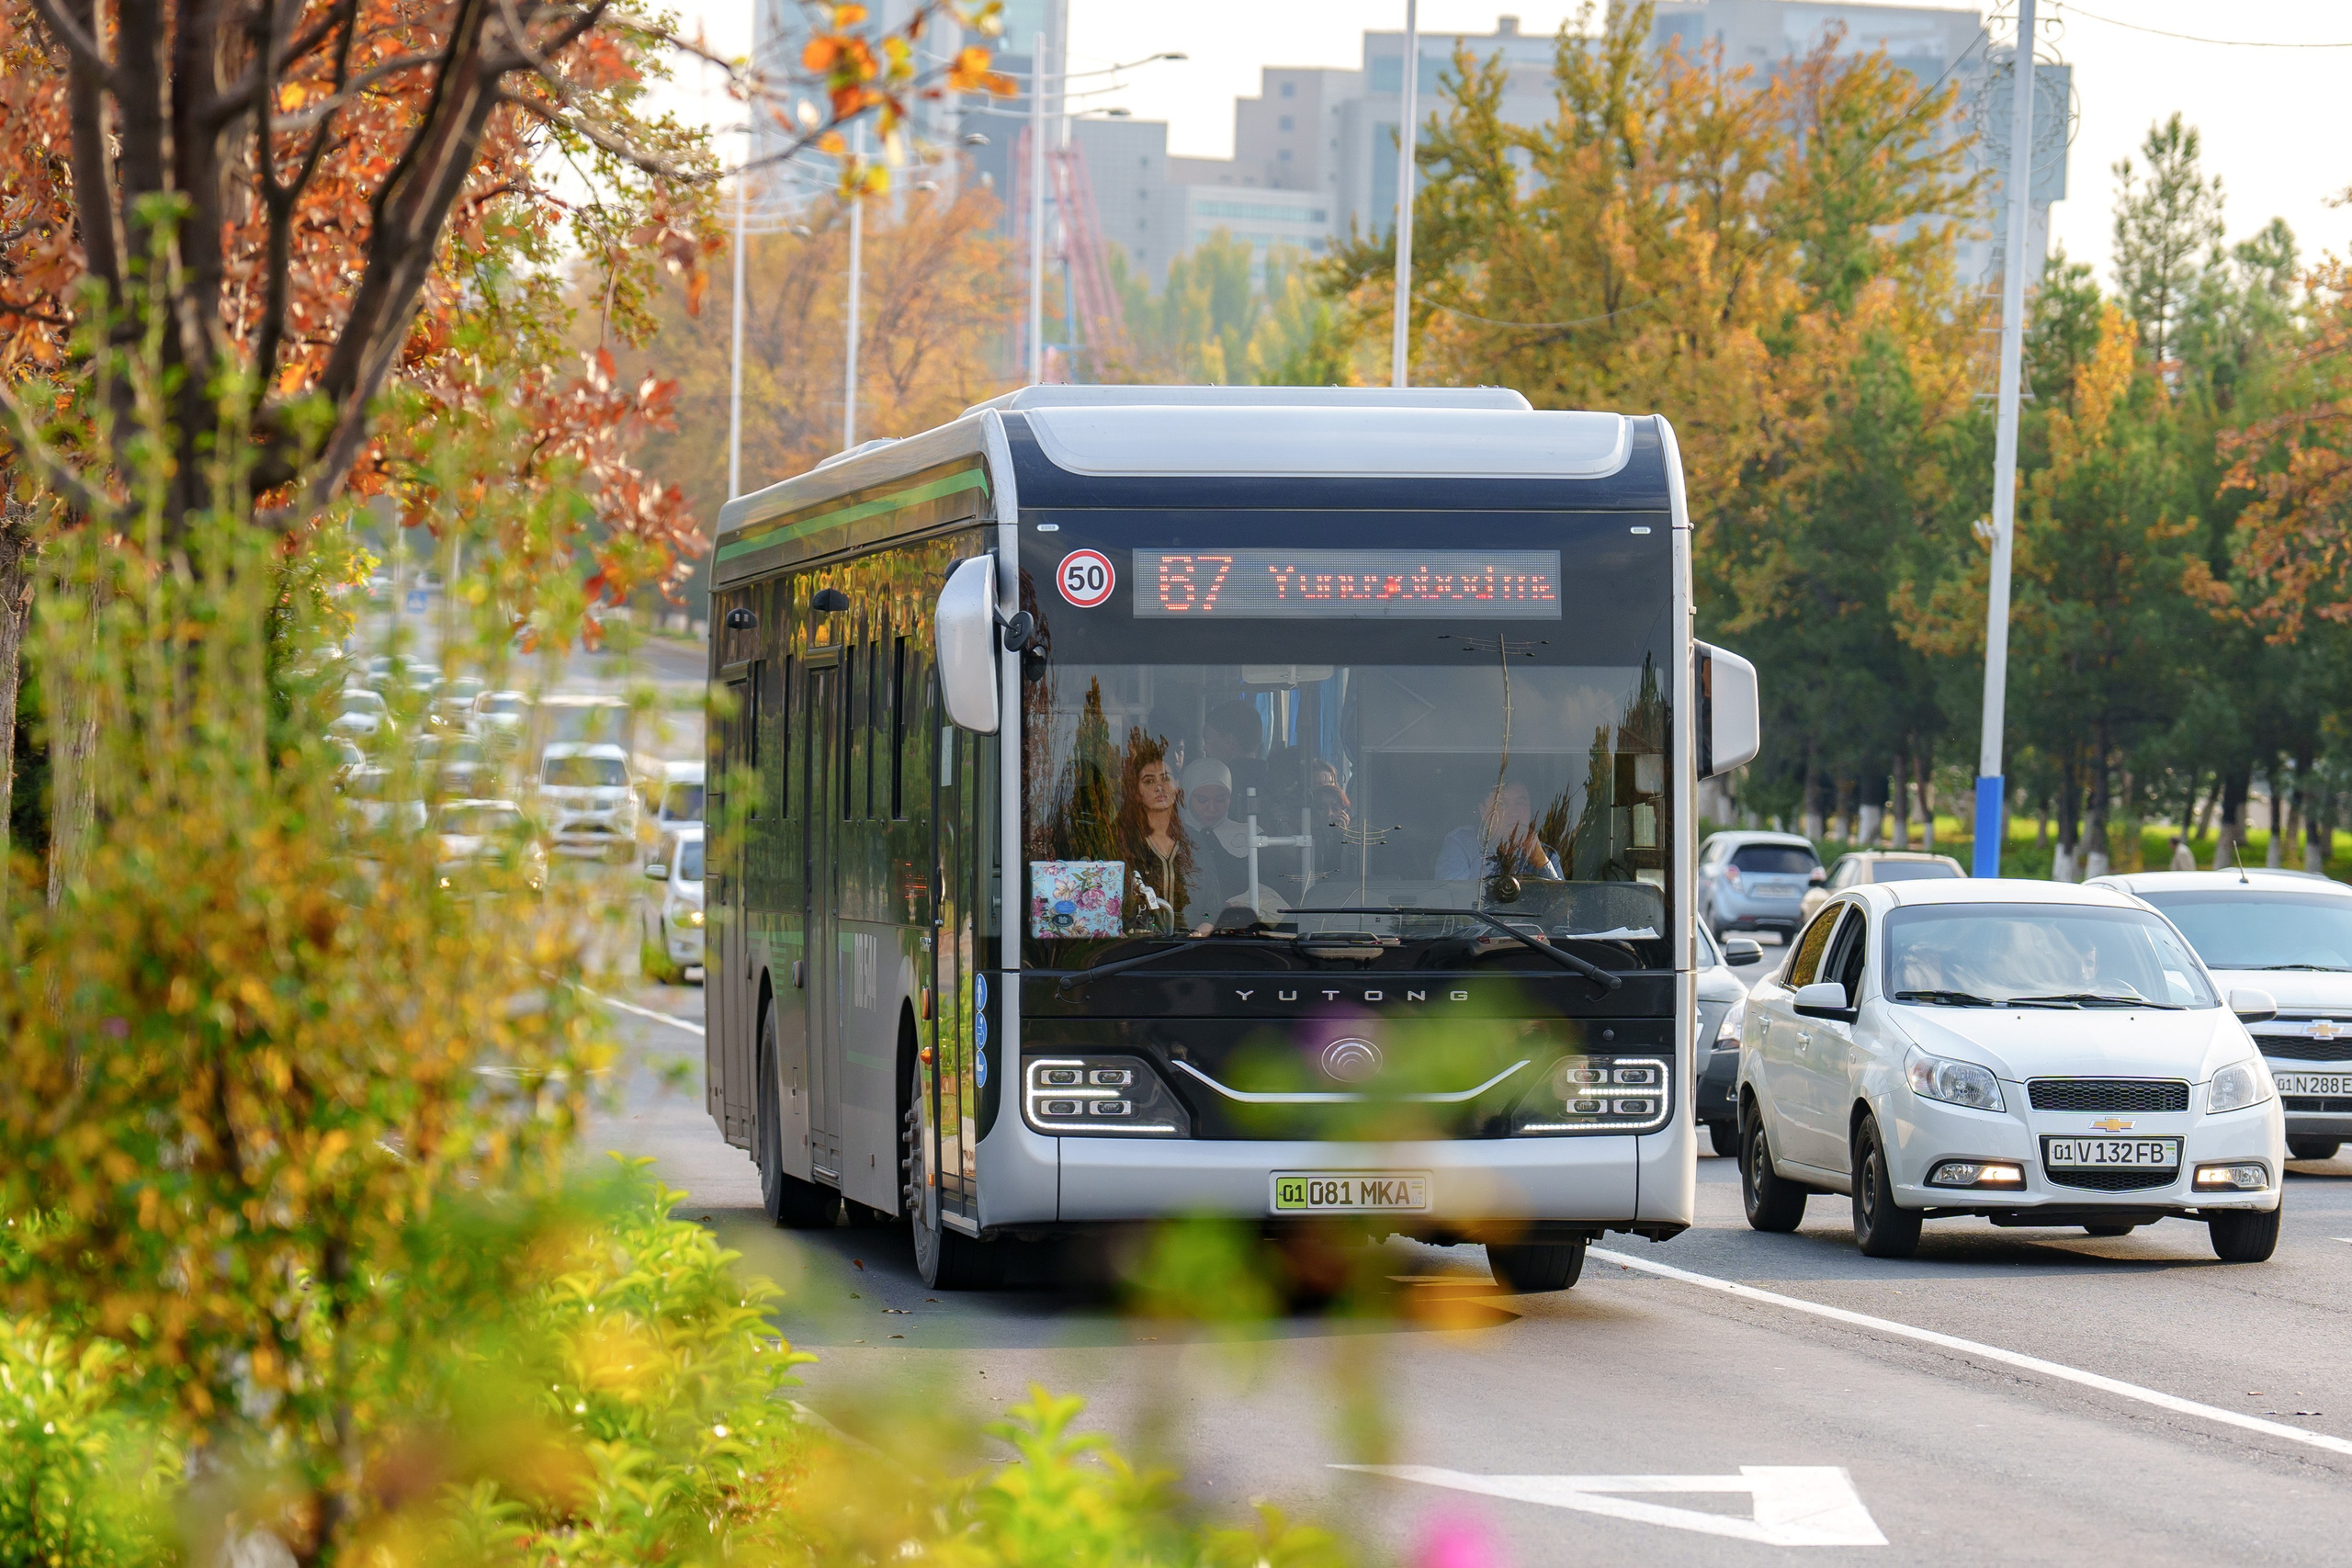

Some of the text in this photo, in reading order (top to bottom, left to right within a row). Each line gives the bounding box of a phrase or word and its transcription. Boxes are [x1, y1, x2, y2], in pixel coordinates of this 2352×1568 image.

[1068, 565, 1104, 591] 50
[1235, 989, 1469, 1001] YUTONG
[2278, 1078, 2292, 1090] 01
[2054, 1145, 2073, 1160] 01
[1283, 1181, 1423, 1205] 01 081 MKA UZ
